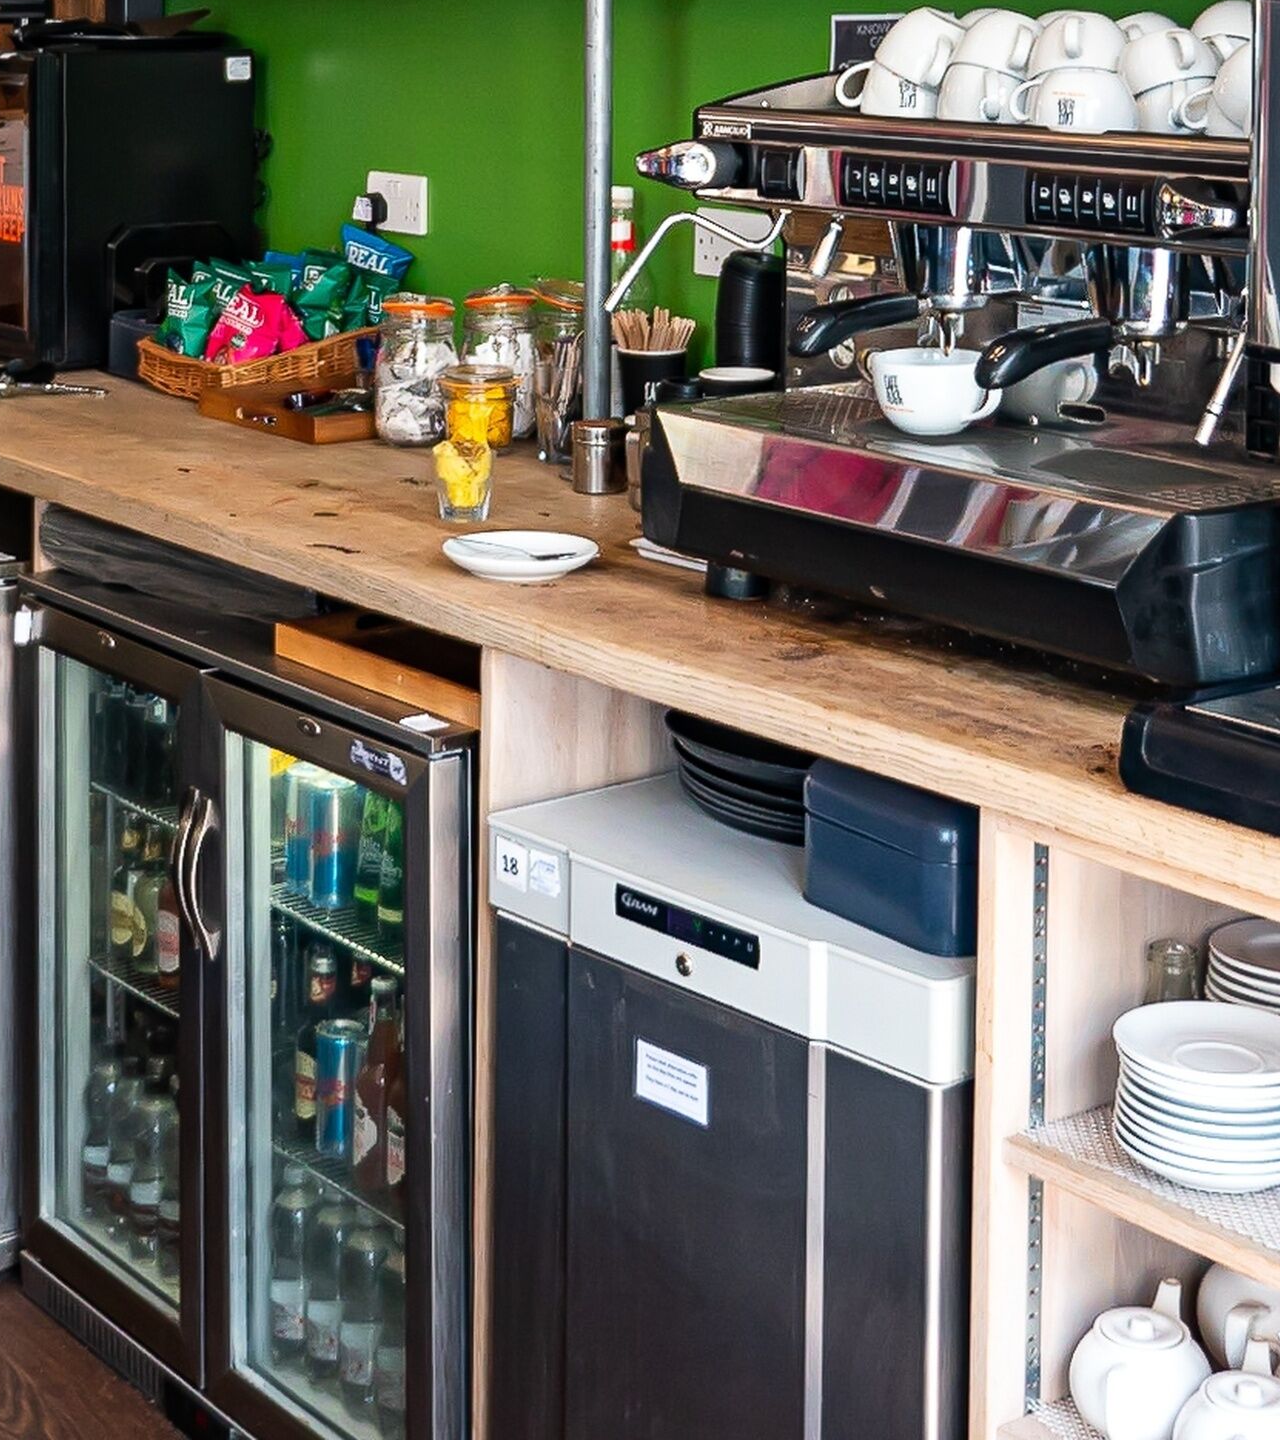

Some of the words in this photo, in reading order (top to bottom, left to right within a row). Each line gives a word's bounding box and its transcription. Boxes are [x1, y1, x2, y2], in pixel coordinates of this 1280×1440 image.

[346, 245, 390, 276] REAL
[501, 853, 520, 876] 18
[620, 891, 659, 917] GRAM
